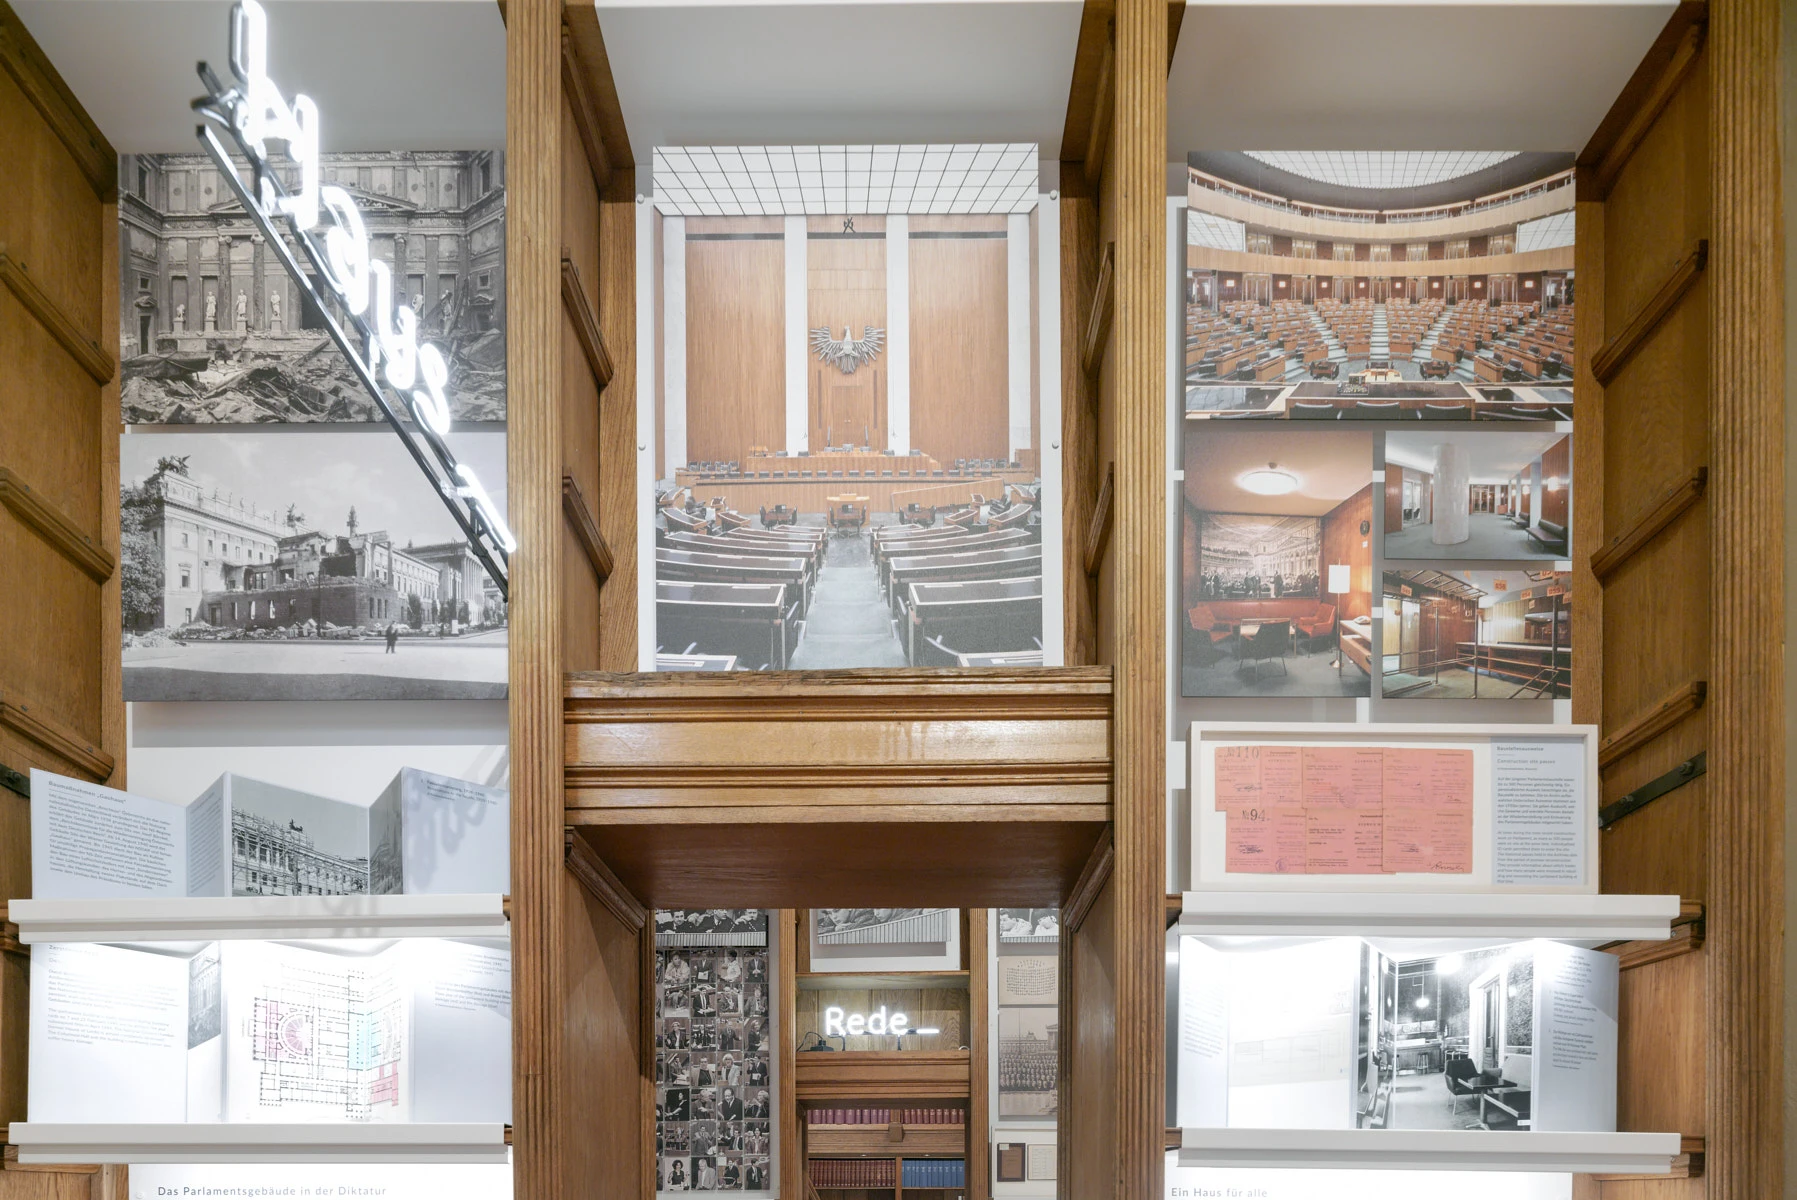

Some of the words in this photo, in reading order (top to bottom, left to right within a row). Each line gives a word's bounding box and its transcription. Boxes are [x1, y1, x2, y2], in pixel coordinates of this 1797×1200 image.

[158, 1186, 179, 1196] Das
[183, 1186, 296, 1197] Parlamentsgebäude
[300, 1186, 310, 1196] in
[315, 1186, 334, 1196] der
[338, 1186, 386, 1196] Diktatur
[1171, 1188, 1189, 1196] Ein
[1194, 1188, 1222, 1197] Haus
[1226, 1188, 1243, 1197] für
[1247, 1189, 1268, 1198] alle
